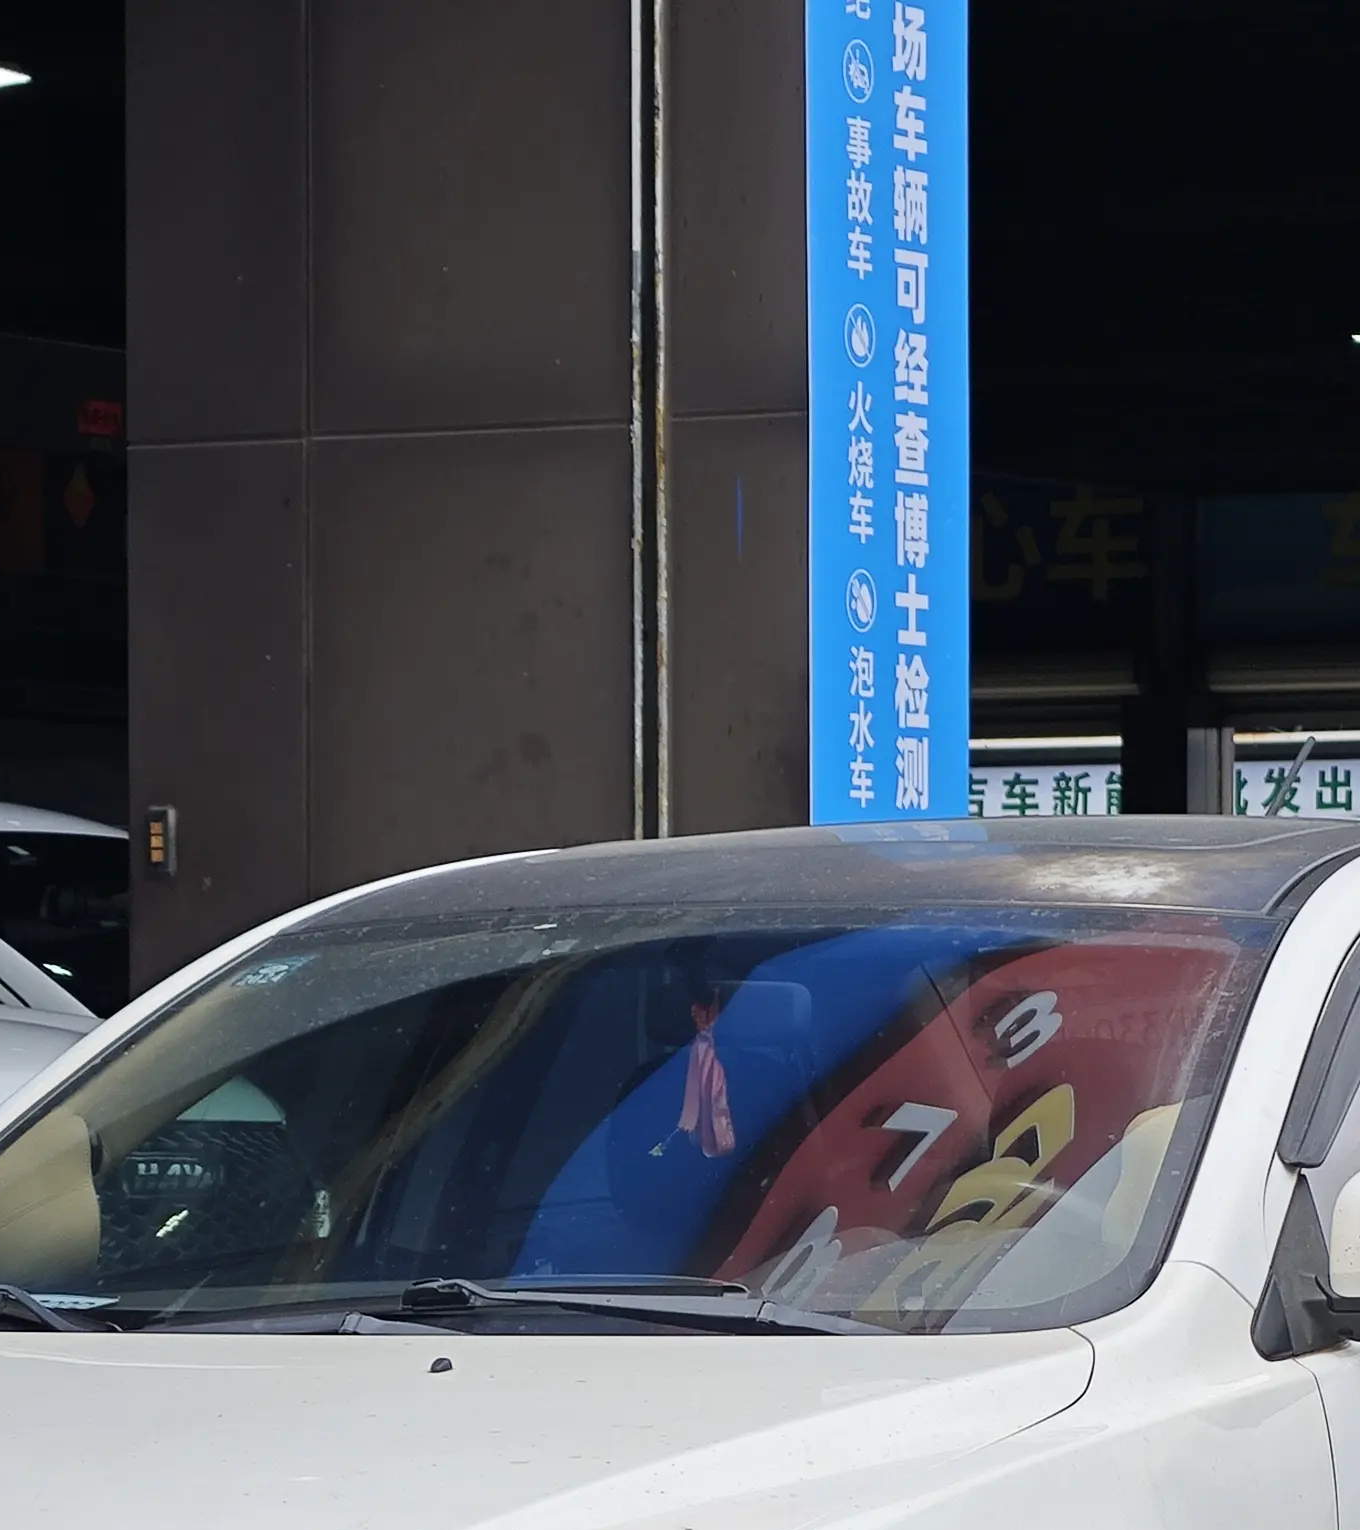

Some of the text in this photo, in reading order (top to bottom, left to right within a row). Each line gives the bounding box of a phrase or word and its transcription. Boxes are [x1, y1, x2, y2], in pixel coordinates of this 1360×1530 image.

[846, 116, 874, 280] 事故车
[848, 381, 875, 544] 火烧车
[892, 2, 930, 811] 场车辆可经查博士检测
[849, 646, 875, 809] 泡水车
